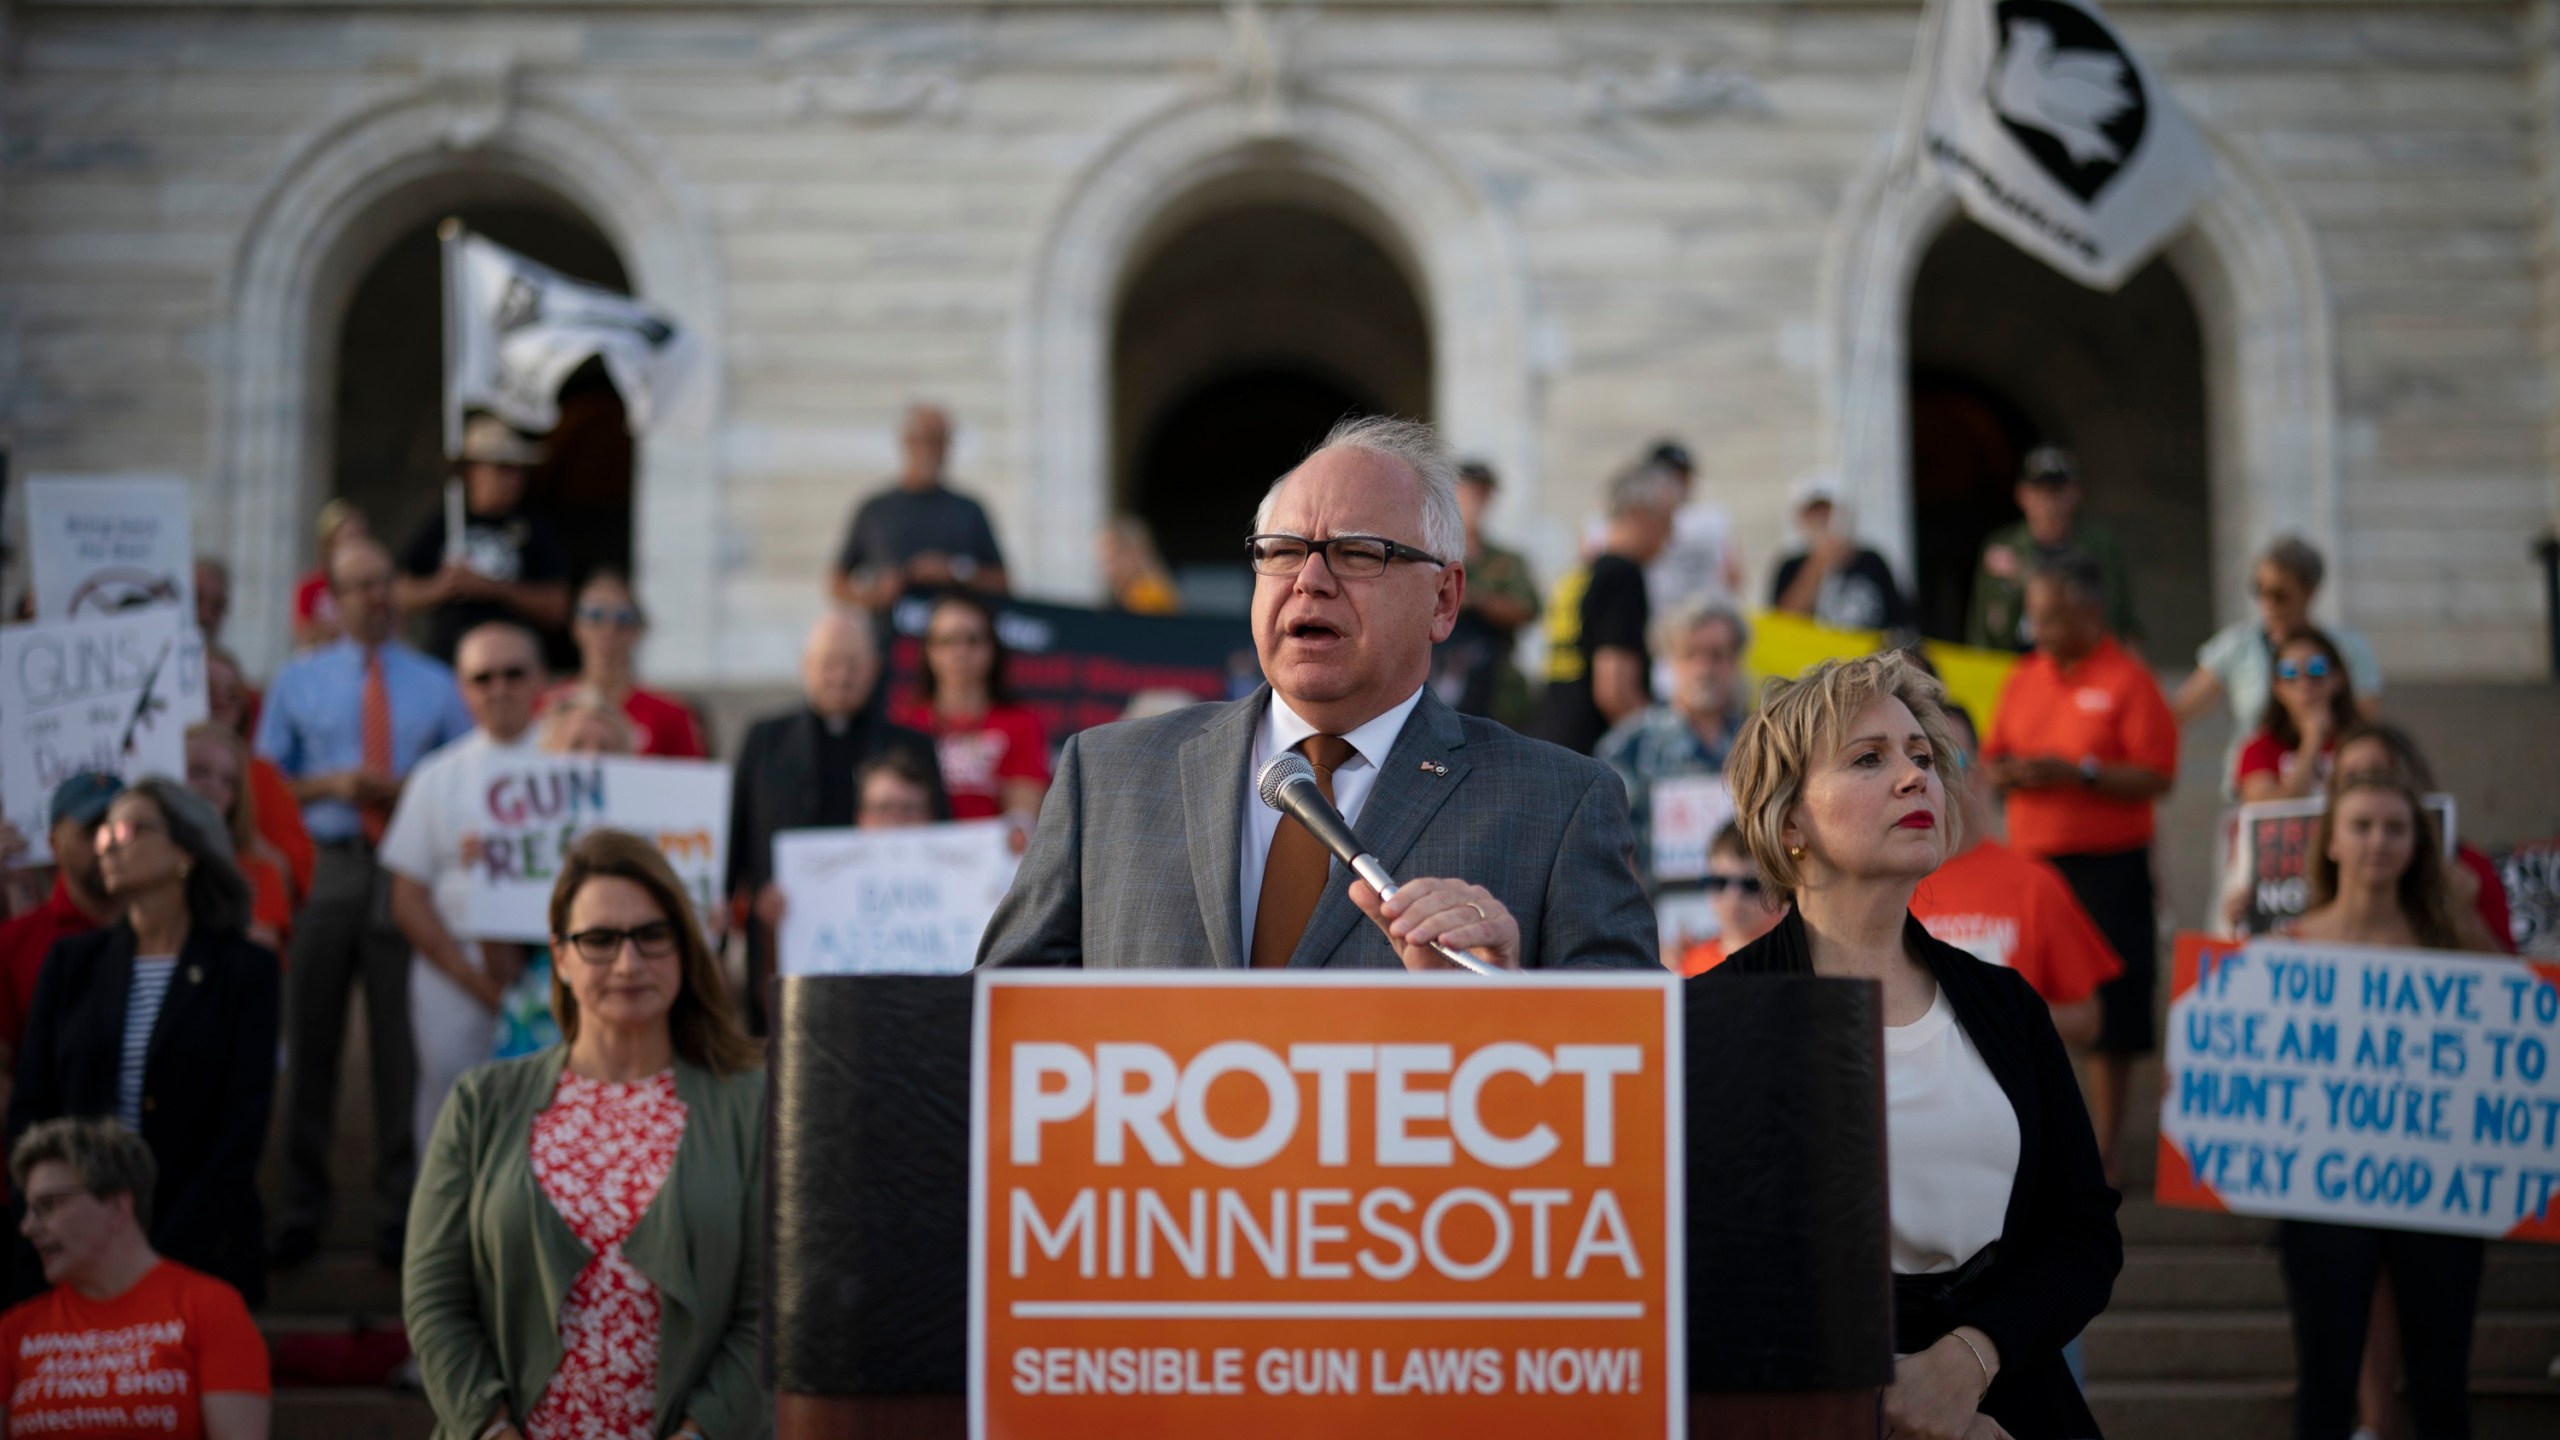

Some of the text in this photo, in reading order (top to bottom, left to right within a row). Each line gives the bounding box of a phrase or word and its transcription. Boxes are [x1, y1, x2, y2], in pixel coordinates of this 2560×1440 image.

[18, 629, 148, 706] GUNS
[487, 767, 605, 827] GUN
[2199, 950, 2559, 1024] IF YOU HAVE TO
[2186, 1010, 2547, 1082] USE AN AR-15 TO
[1011, 1041, 1643, 1168] PROTECT
[2180, 1069, 2306, 1134] HUNT,
[2473, 1096, 2560, 1150] NOT
[2185, 1138, 2560, 1222] VERY GOOD AT IT
[1010, 1187, 1643, 1280] MINNESOTA
[20, 1319, 186, 1359] MINNESOTAN
[37, 1347, 156, 1375] AGAINST
[1012, 1347, 1642, 1394] SENSIBLE GUN LAWS NOW!
[11, 1368, 188, 1406] ETTING SHOT
